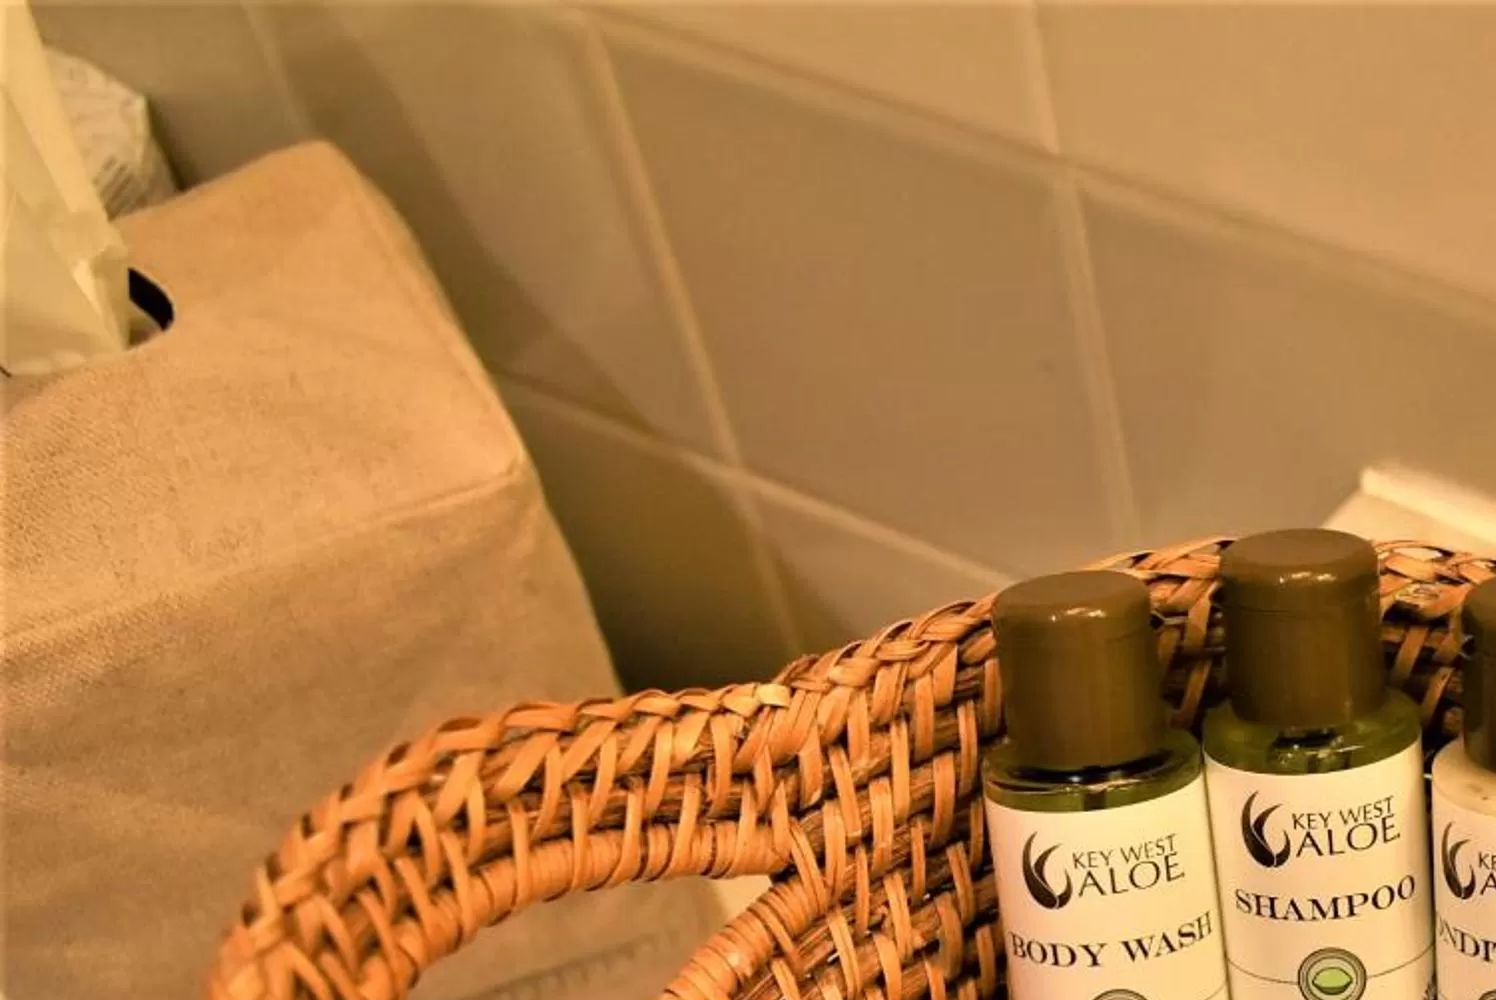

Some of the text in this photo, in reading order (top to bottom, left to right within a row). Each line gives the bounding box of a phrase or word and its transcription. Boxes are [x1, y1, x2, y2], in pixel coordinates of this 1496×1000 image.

[1292, 796, 1395, 832] KEY WEST
[1296, 814, 1401, 859] ALOE
[1072, 833, 1177, 870] KEY WEST
[1077, 853, 1186, 898] ALOE
[1234, 874, 1417, 922] SHAMPOO
[1008, 911, 1213, 968] BODY WASH
